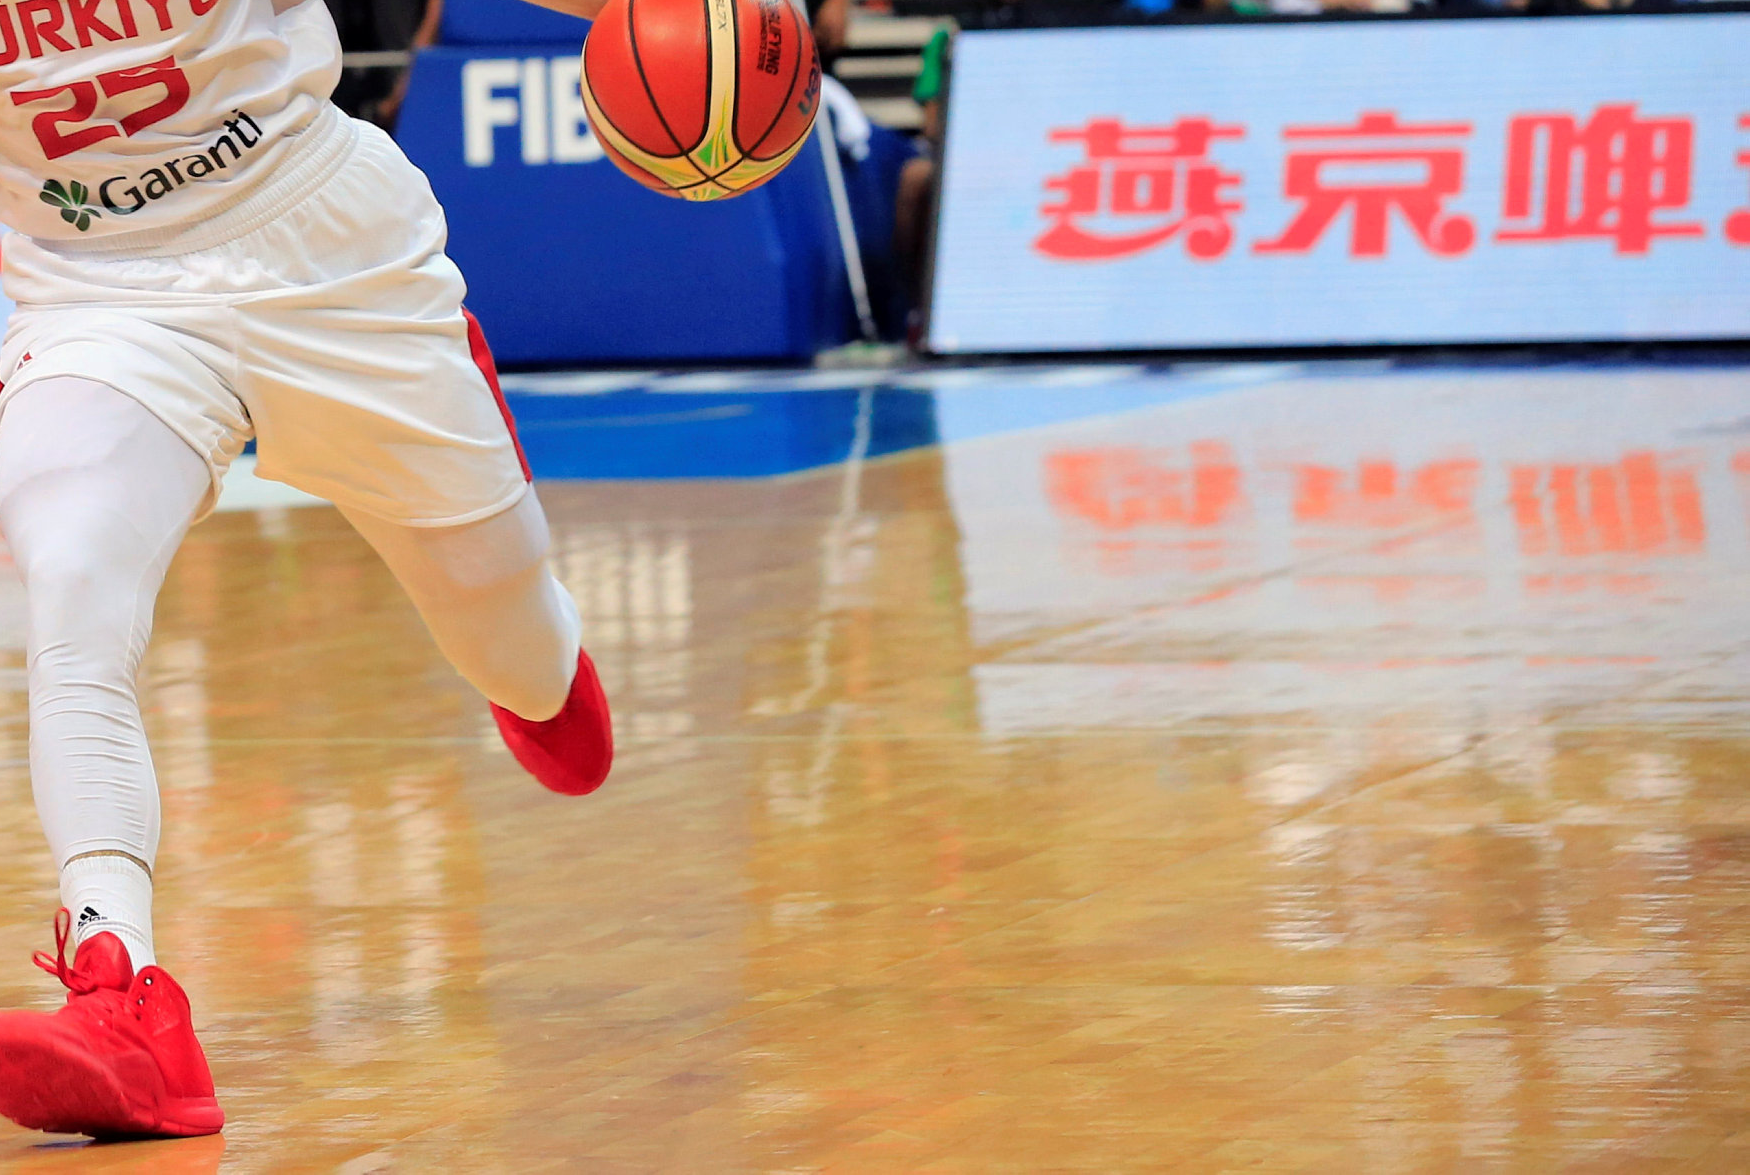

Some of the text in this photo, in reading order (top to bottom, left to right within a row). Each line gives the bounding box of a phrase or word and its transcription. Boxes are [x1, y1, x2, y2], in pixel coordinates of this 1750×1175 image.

[9, 54, 191, 161] 25
[98, 107, 264, 216] Garanti
[460, 56, 608, 168] FIB
[1032, 103, 1750, 261] 燕京啤
